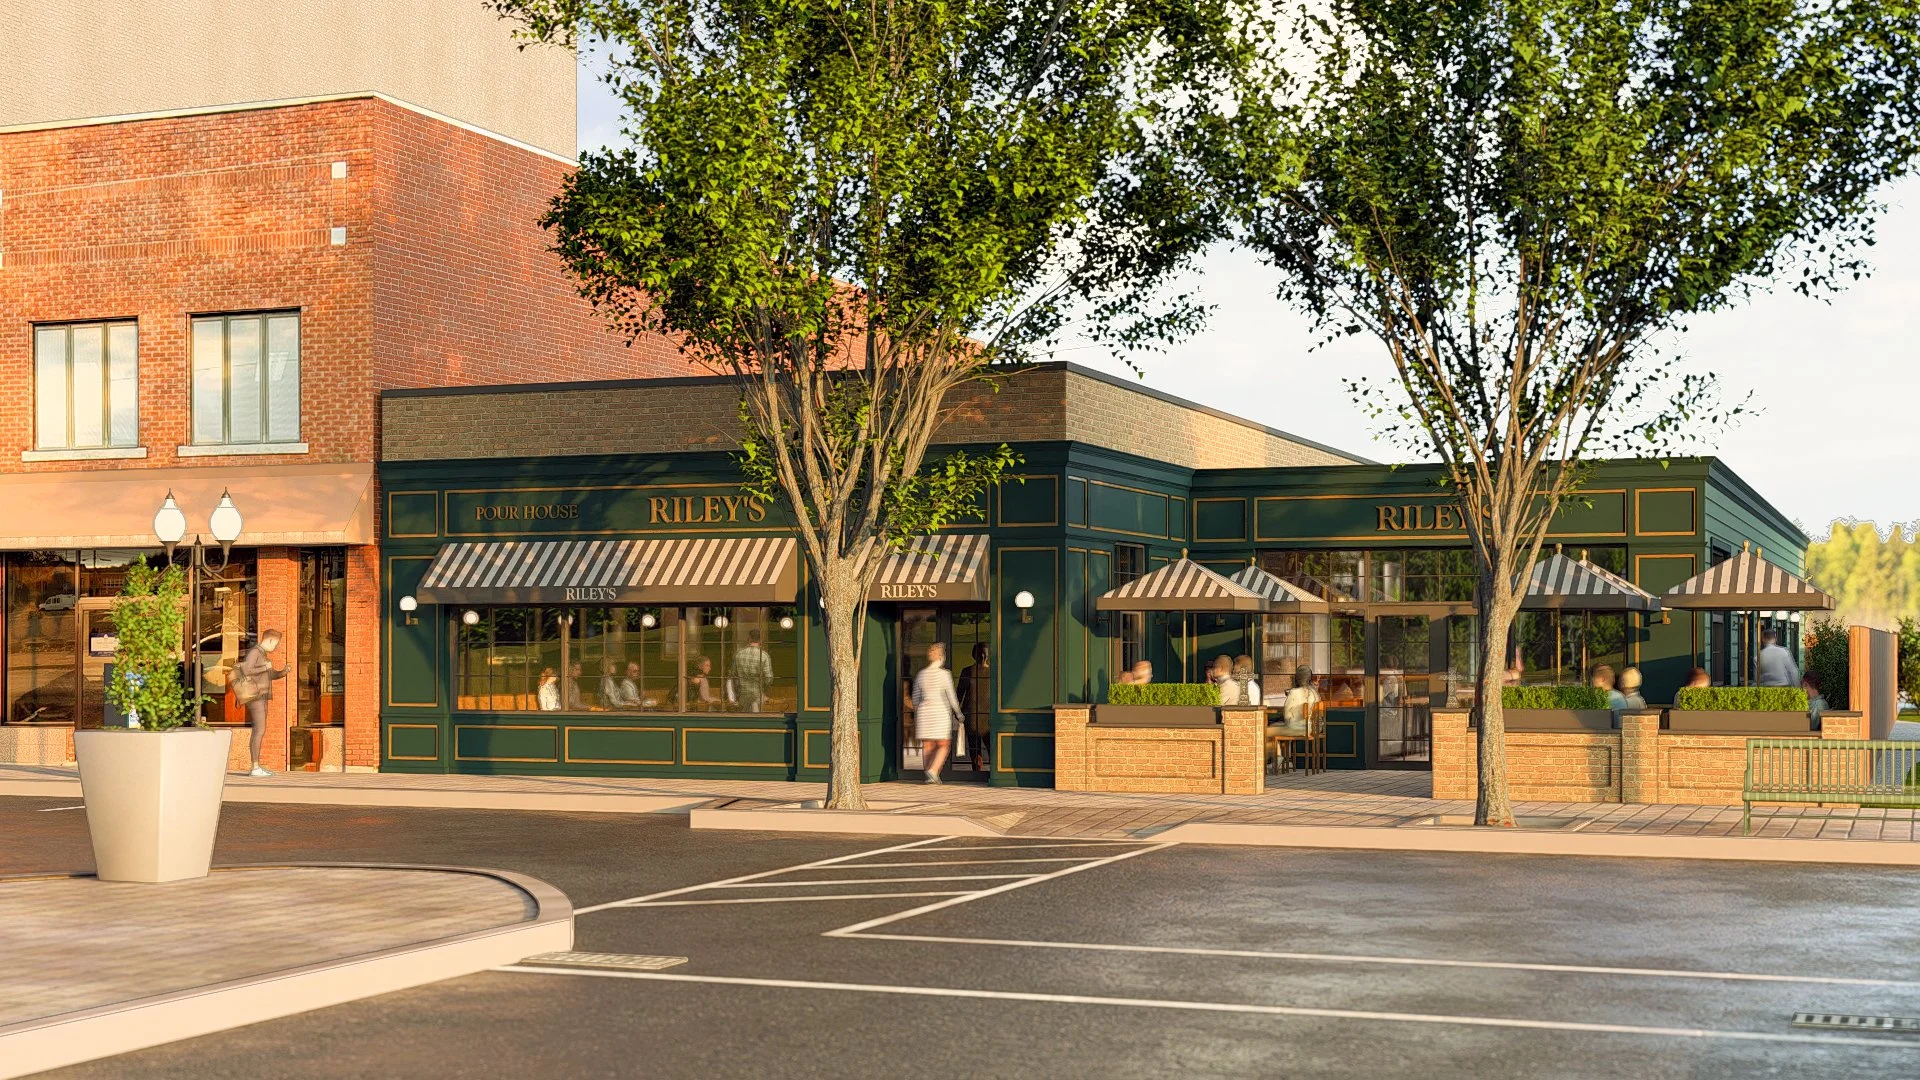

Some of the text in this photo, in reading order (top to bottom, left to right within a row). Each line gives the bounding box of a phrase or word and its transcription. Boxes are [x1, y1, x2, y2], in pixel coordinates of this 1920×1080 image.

[475, 504, 579, 521] POUR HOUSE
[648, 495, 766, 524] RILEY'S
[1376, 503, 1493, 531] RILEYS
[565, 587, 617, 601] RILEY'S
[880, 584, 938, 599] RILEY'S
